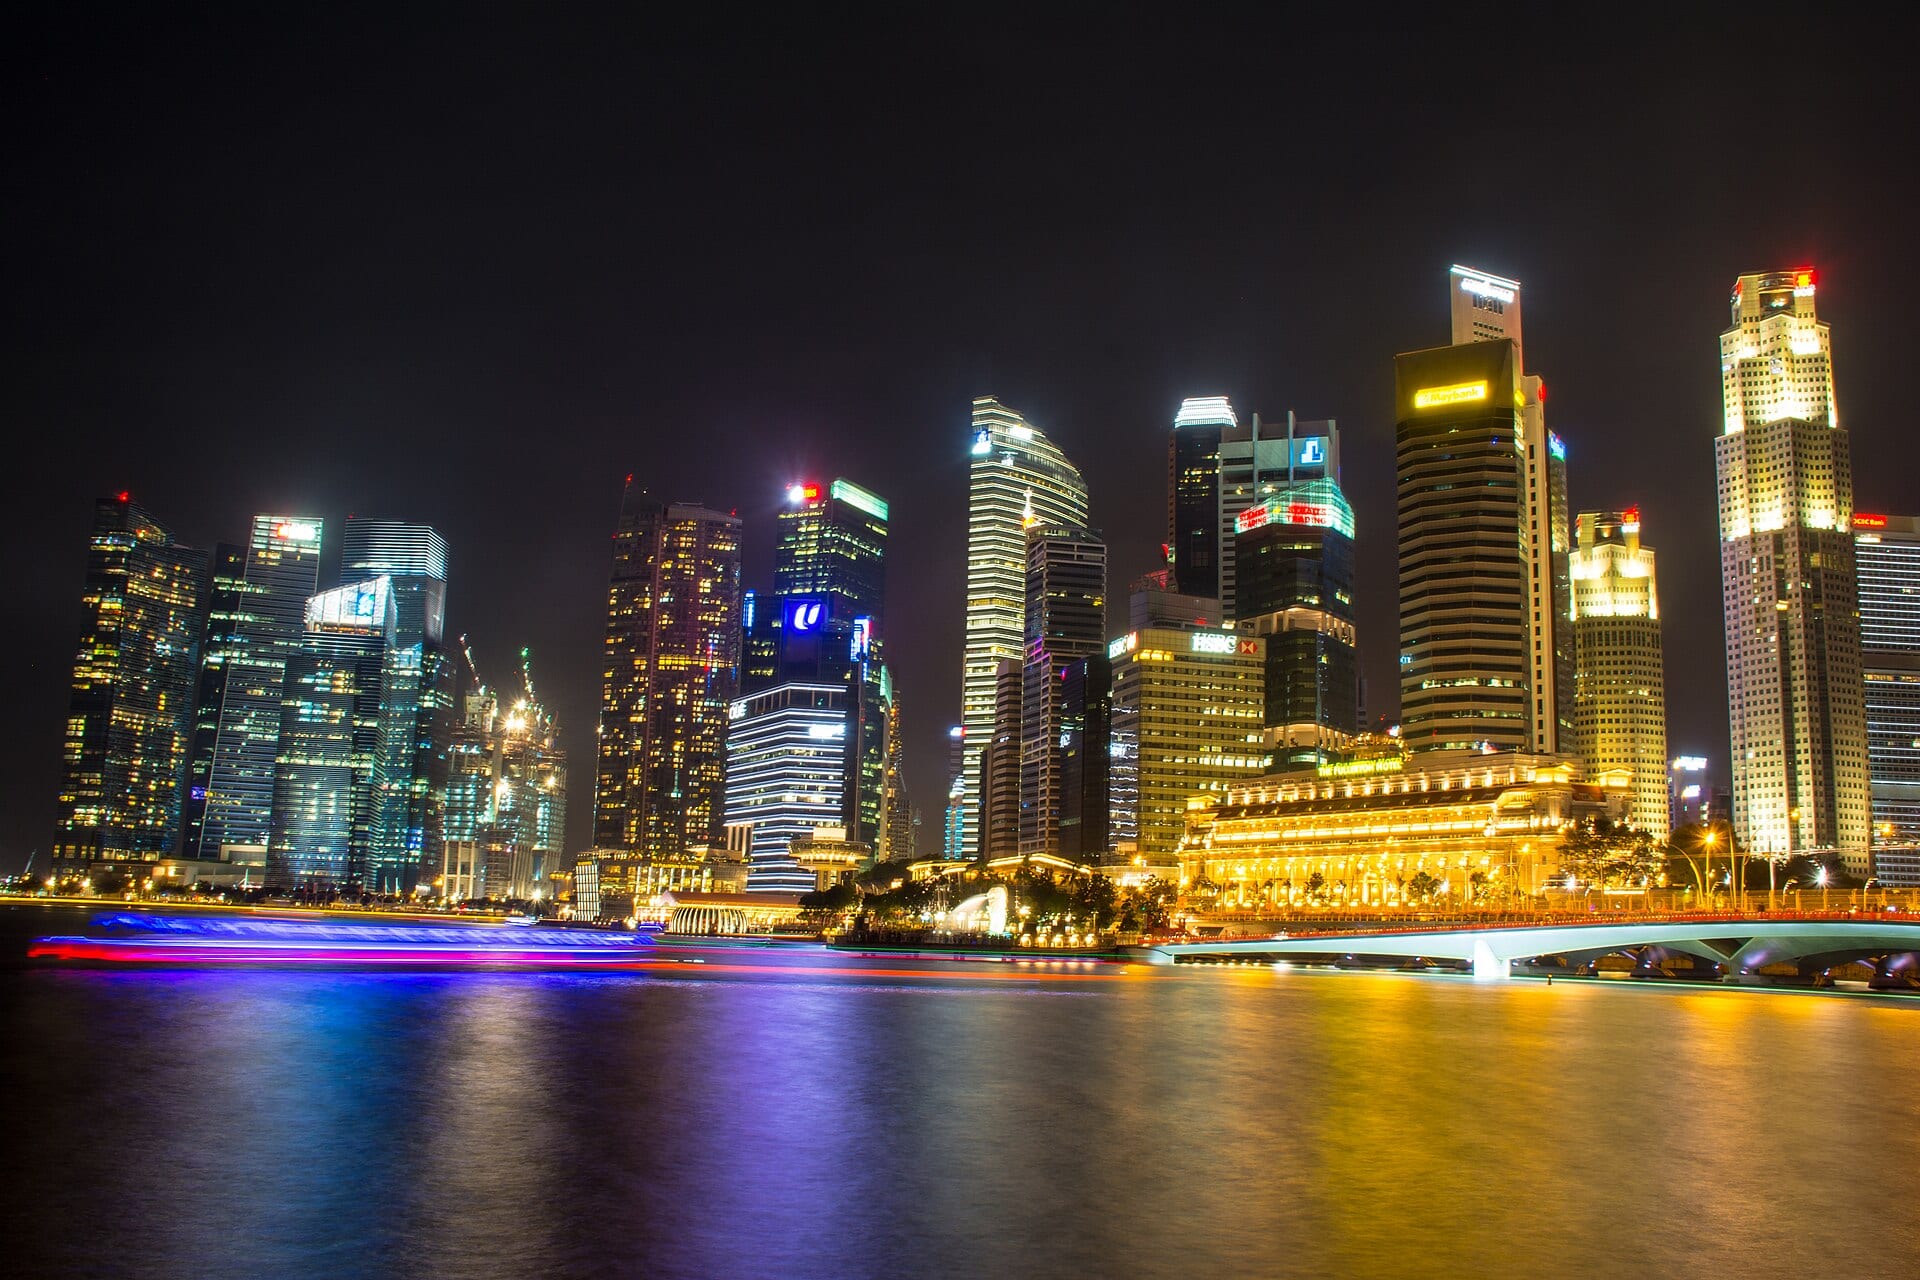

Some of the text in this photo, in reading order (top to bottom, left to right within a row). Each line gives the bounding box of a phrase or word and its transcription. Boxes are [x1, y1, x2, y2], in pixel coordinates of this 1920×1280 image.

[1430, 388, 1480, 402] Maybank
[1286, 515, 1327, 525] TRADING
[1191, 633, 1238, 654] HSBC
[1318, 759, 1402, 776] THE FULLERTON HOTEL
